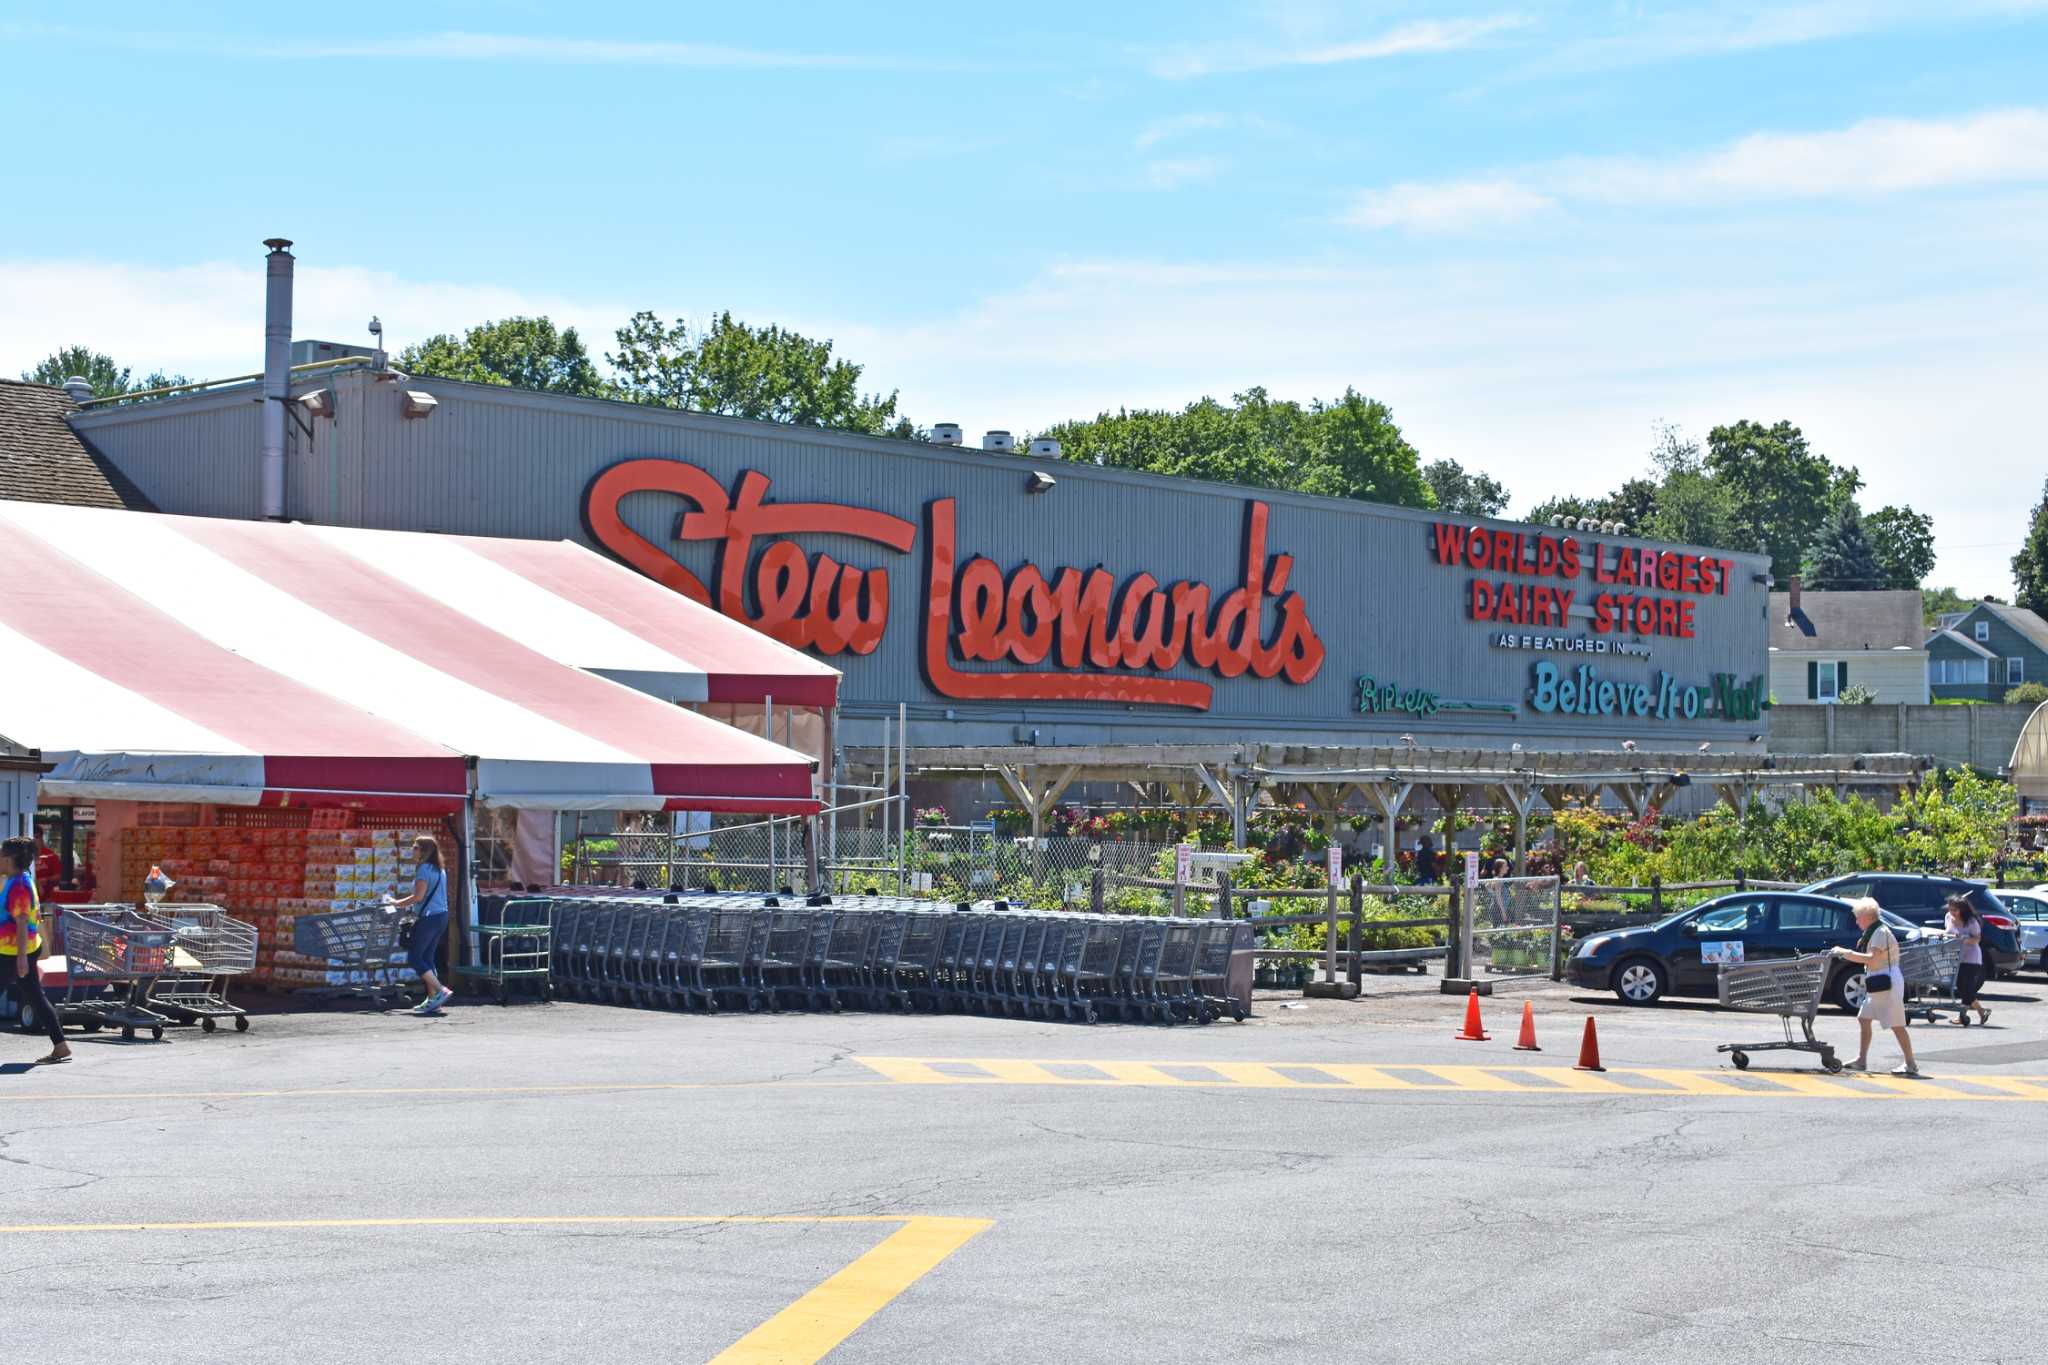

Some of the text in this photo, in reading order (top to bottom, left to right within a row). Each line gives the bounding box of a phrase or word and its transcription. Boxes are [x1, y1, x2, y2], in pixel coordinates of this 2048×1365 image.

[586, 457, 1326, 712] Stew Leonard's
[1595, 543, 1734, 597] LARGEST
[1472, 579, 1697, 638] DAIRY STORE
[1500, 634, 1514, 648] AS
[1522, 636, 1605, 653] FEATURED
[1612, 642, 1625, 654] IN
[1533, 661, 1649, 717] Believe
[1655, 670, 1677, 720] It
[1683, 685, 1711, 720] or
